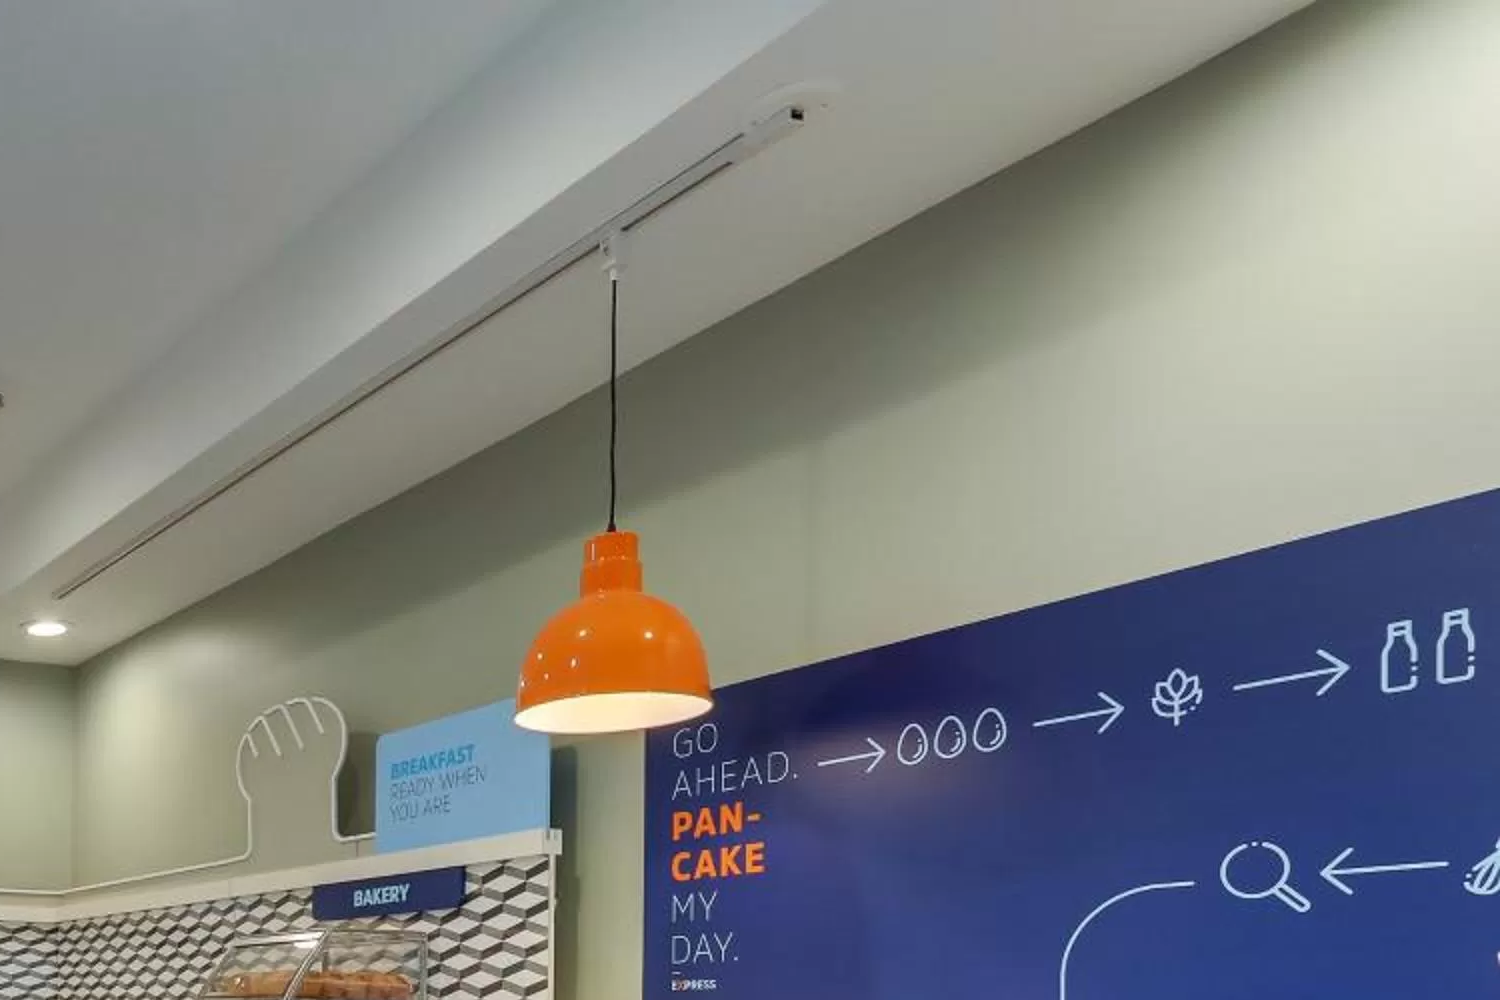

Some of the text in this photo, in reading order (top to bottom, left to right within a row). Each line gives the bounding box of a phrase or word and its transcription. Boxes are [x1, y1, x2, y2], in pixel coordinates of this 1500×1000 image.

[673, 723, 718, 758] GO
[390, 744, 475, 779] BREAKFAST
[672, 751, 798, 800] AHEAD.
[390, 766, 486, 799] READY WHEN
[389, 795, 451, 822] YOU ARE
[672, 801, 762, 841] PAN-
[671, 841, 765, 882] CAKE
[353, 884, 410, 907] BAKERY
[672, 891, 717, 923] MY
[671, 931, 739, 965] DAY.
[671, 979, 717, 991] EXPRESS
